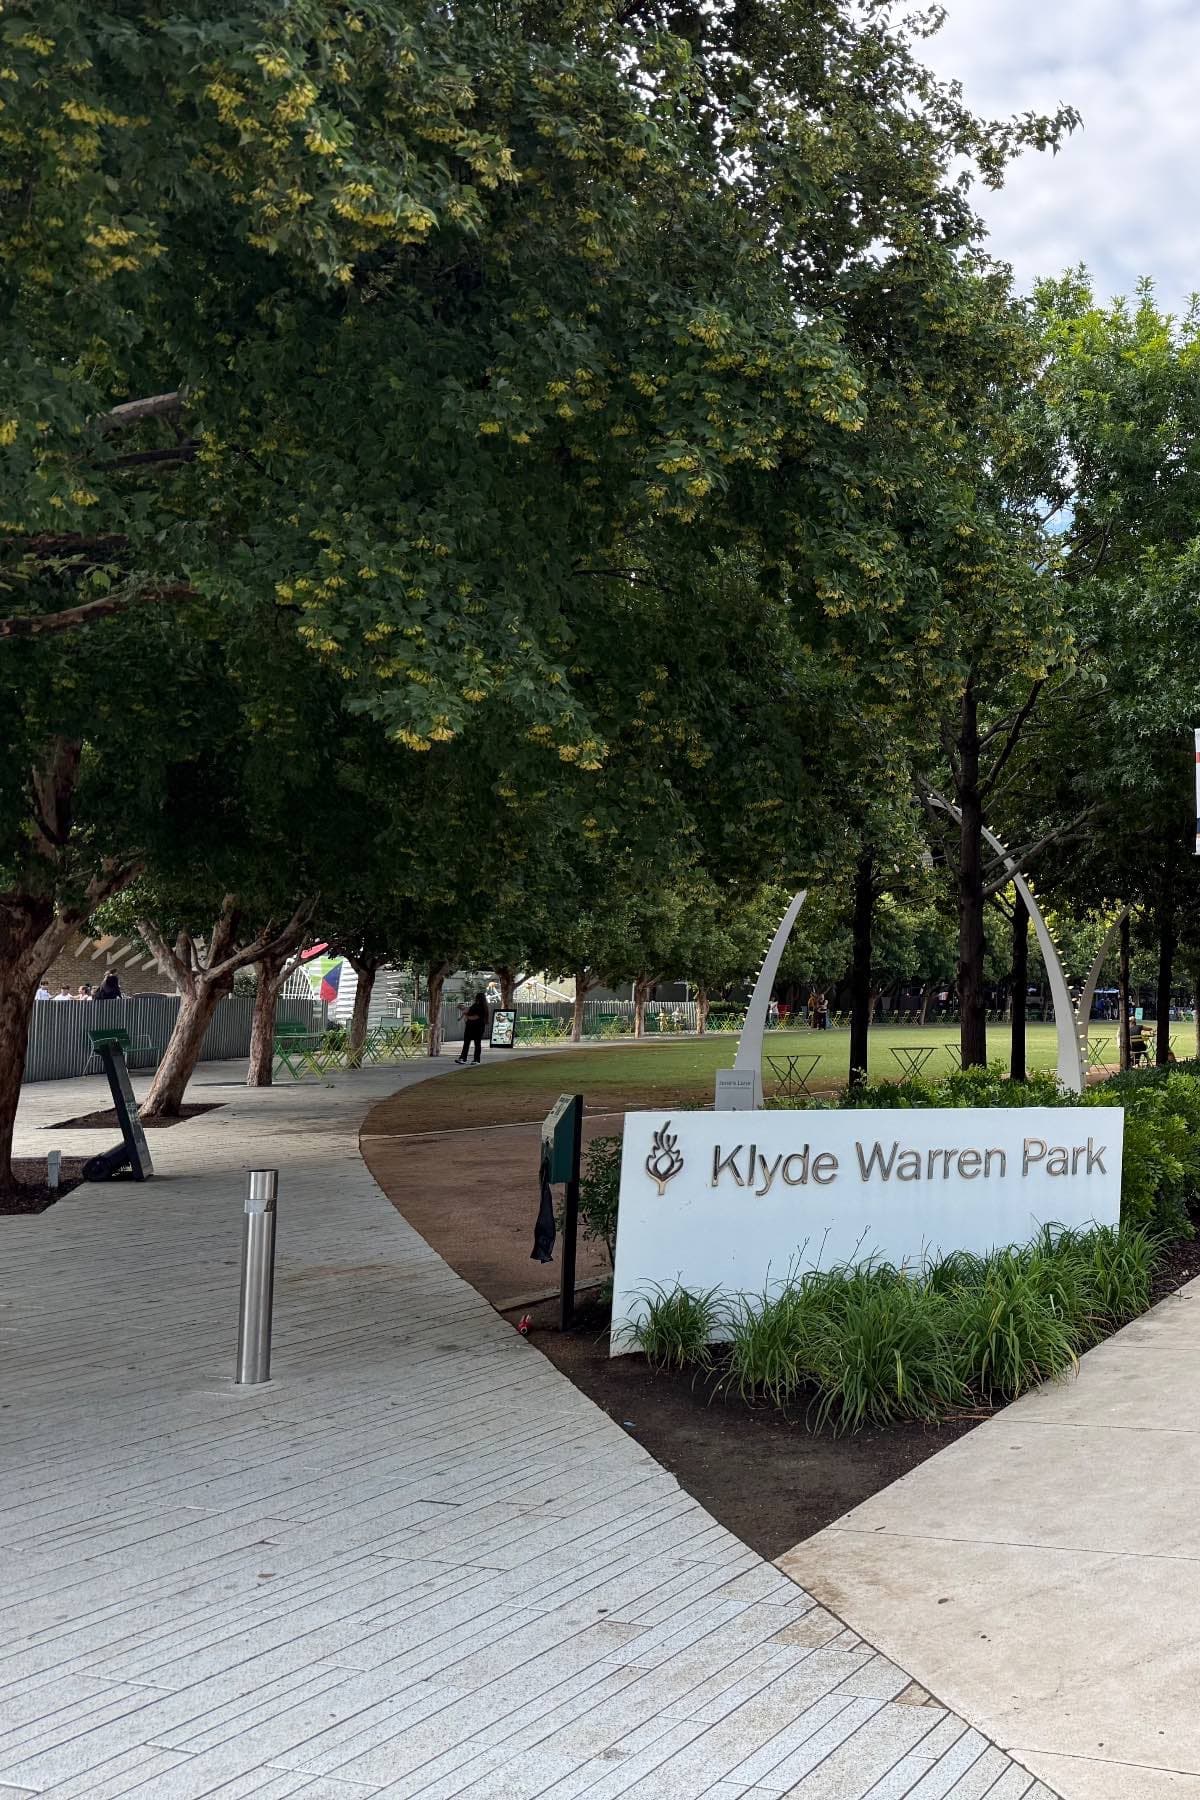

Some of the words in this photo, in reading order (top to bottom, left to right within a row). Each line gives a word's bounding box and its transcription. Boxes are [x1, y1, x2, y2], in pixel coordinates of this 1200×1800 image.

[710, 1143, 839, 1196] Klyde
[855, 1140, 1007, 1182] Warren
[1022, 1136, 1107, 1177] Park
